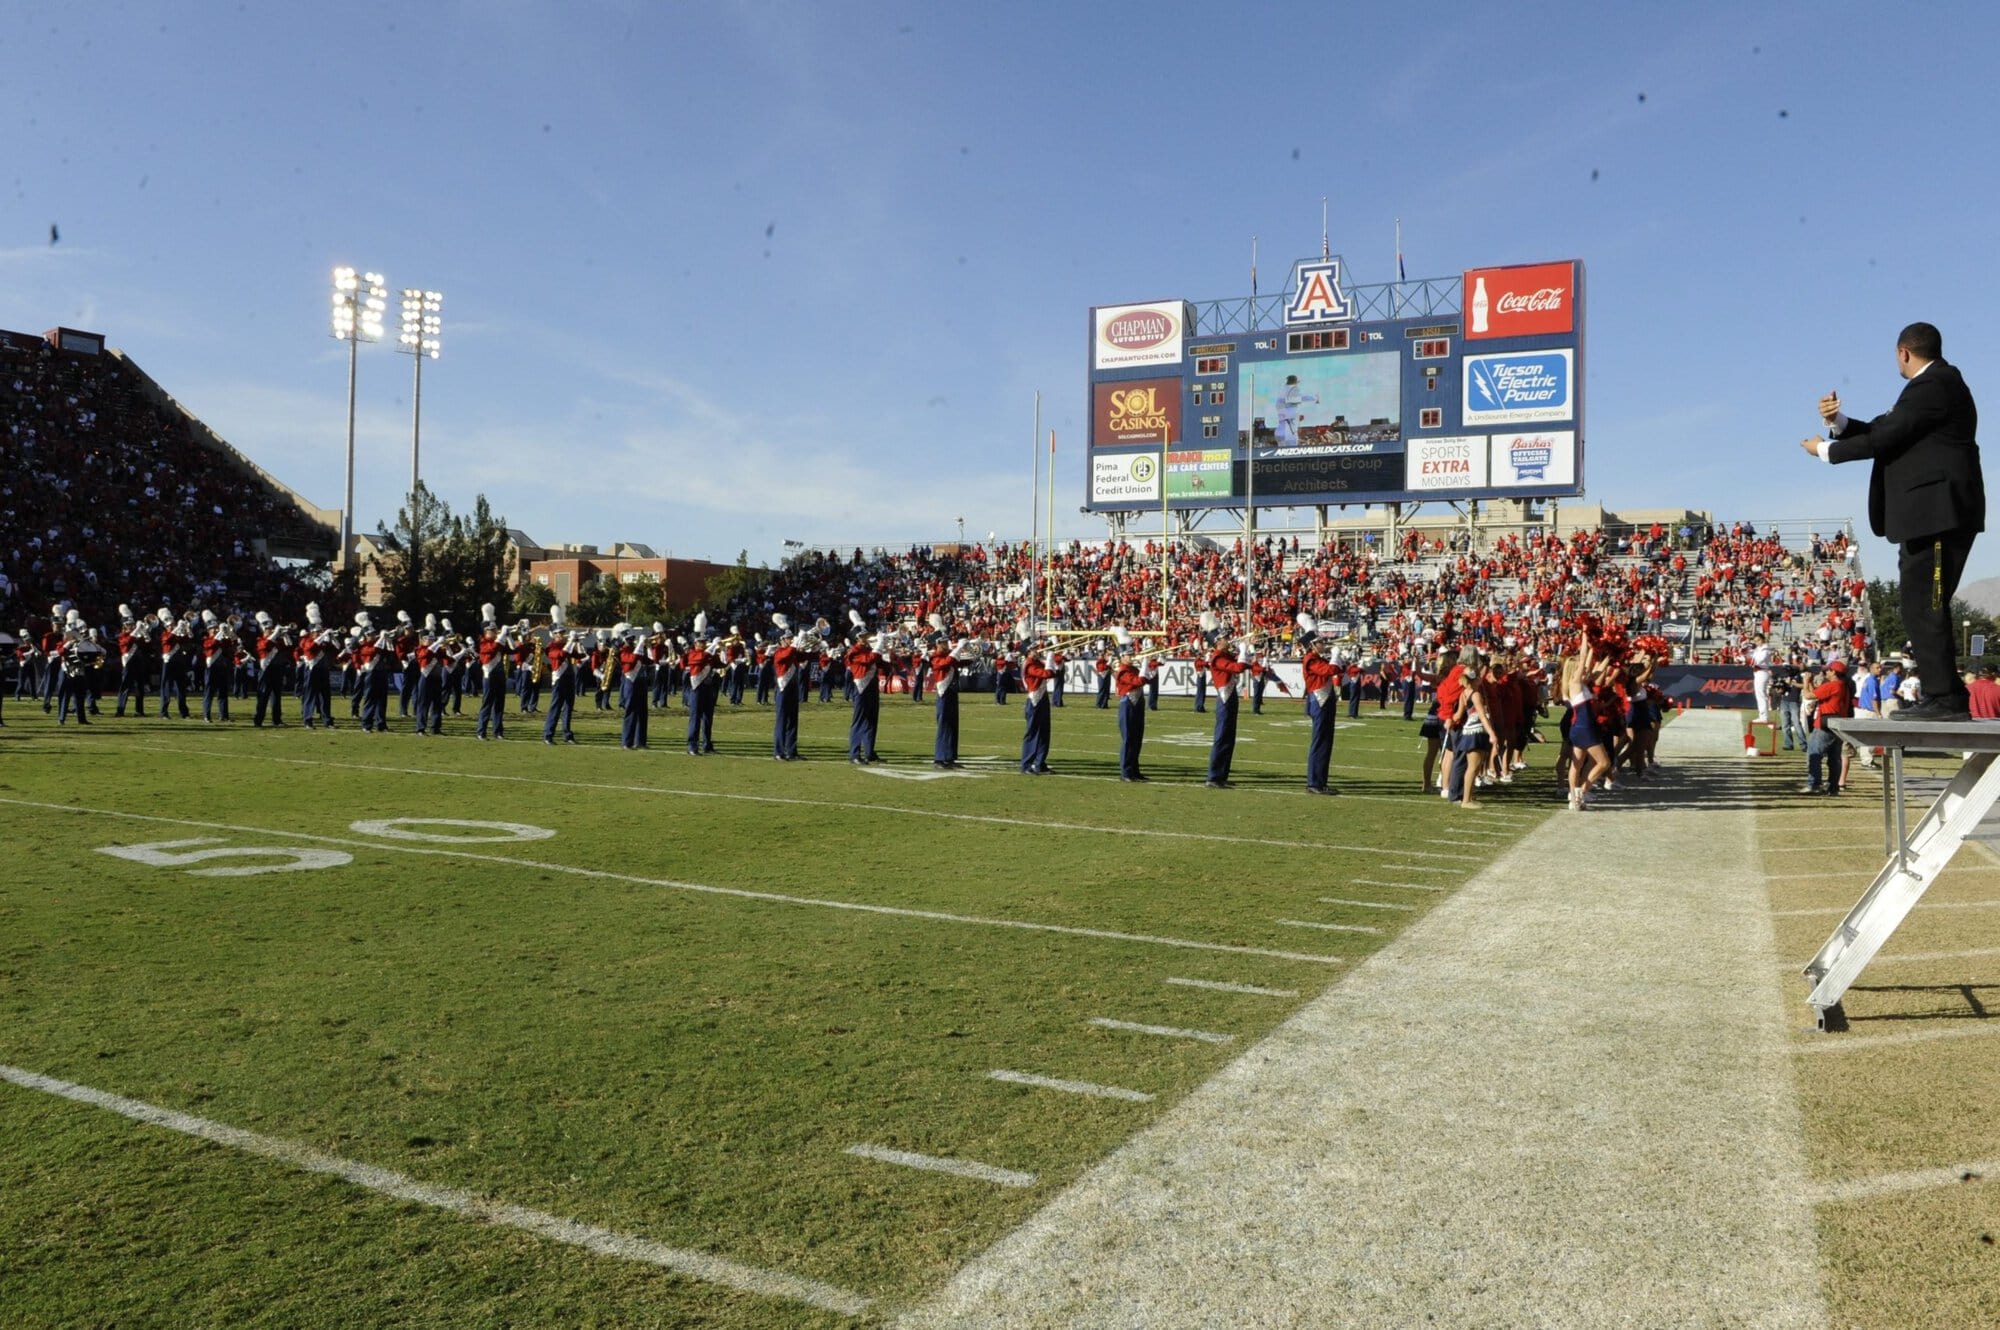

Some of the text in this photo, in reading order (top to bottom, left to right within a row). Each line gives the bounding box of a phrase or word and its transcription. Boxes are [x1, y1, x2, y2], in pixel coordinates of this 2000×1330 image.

[1286, 263, 1350, 323] A
[1497, 287, 1566, 314] Coca-Cola
[1111, 318, 1166, 337] CHAPMAN
[1113, 333, 1165, 343] AUTOMOTIVE
[1366, 332, 1384, 340] TOL
[1254, 341, 1270, 349] TOL
[1101, 352, 1176, 364] CHAPMANTUCSON.COM
[1492, 364, 1543, 378] Tucson
[1497, 374, 1557, 390] Electric
[1109, 387, 1166, 418] SOL
[1503, 389, 1557, 403] Power
[1109, 415, 1166, 431] CASINOS
[1421, 445, 1470, 460] SPORTS
[1096, 463, 1118, 472] Pima
[1341, 457, 1383, 471] Group
[1422, 460, 1470, 474] EXTRA
[1096, 474, 1129, 484] Federal
[1421, 475, 1471, 488] MONDAYS
[1096, 484, 1152, 495] Credit Union
